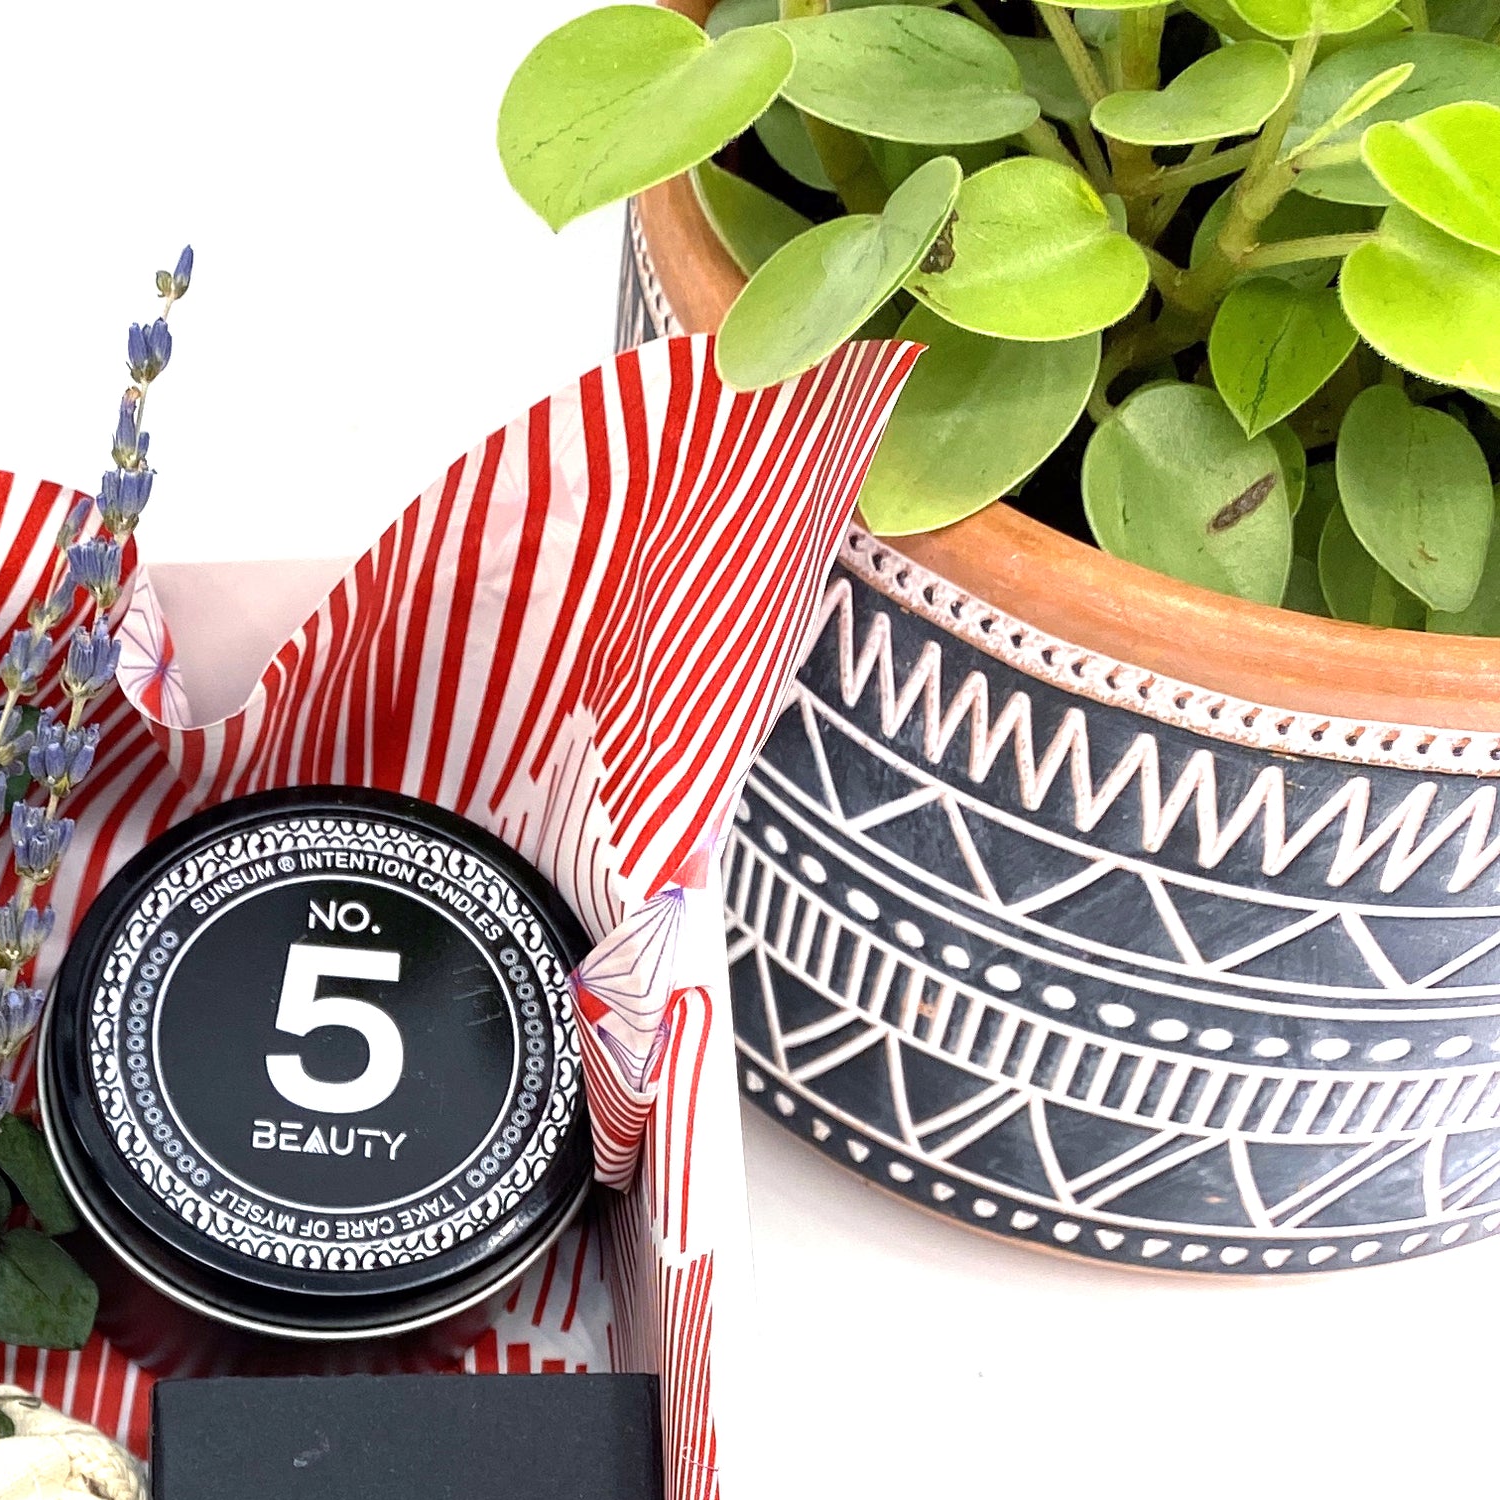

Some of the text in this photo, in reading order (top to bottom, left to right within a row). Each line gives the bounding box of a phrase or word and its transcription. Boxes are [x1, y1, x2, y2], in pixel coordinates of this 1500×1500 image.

[189, 858, 276, 915] SUNSUM
[300, 851, 417, 884] INTENTION
[417, 872, 504, 941] CANDLES
[308, 899, 381, 934] NO.
[265, 942, 404, 1114] 5
[252, 1120, 407, 1161] BEAUTY
[209, 1185, 467, 1239] I TAKE CARE OF MYSELF
